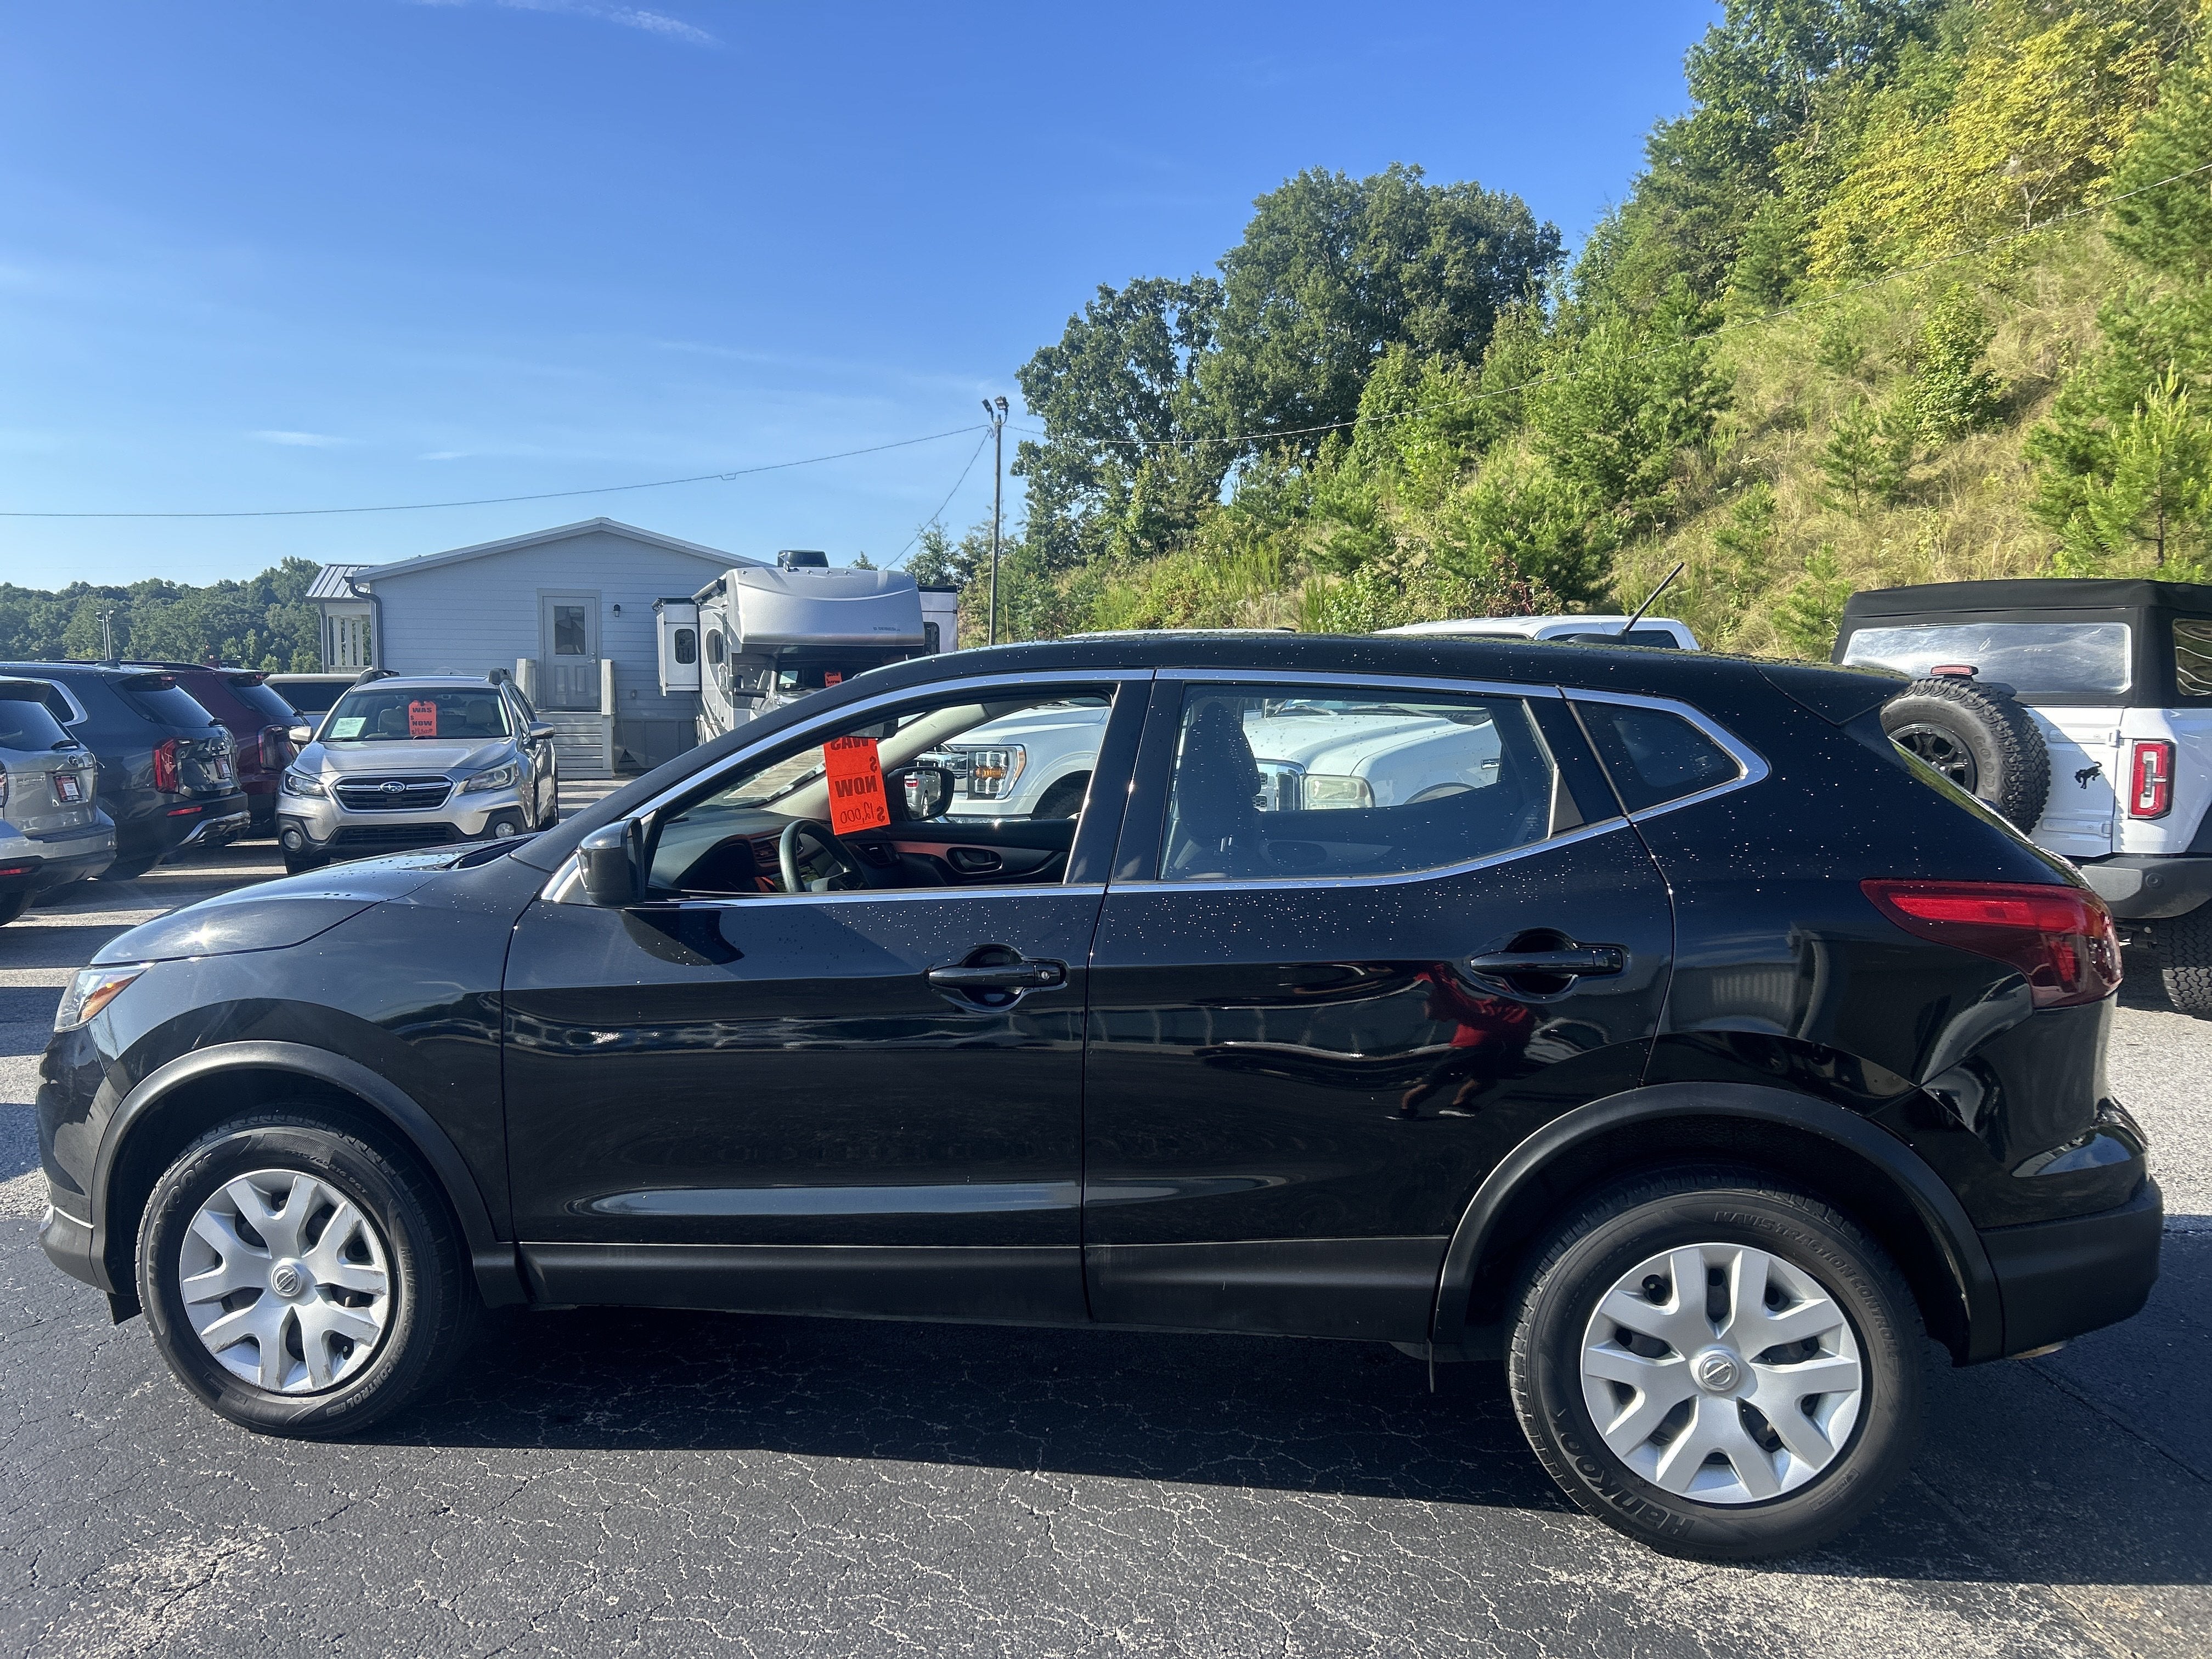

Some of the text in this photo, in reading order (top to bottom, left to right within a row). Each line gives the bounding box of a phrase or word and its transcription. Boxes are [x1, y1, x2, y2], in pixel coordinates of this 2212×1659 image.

[1713, 1211, 1899, 1348] MAVIS TRACTION CONTROL
[346, 1362, 394, 1408] CONTROL
